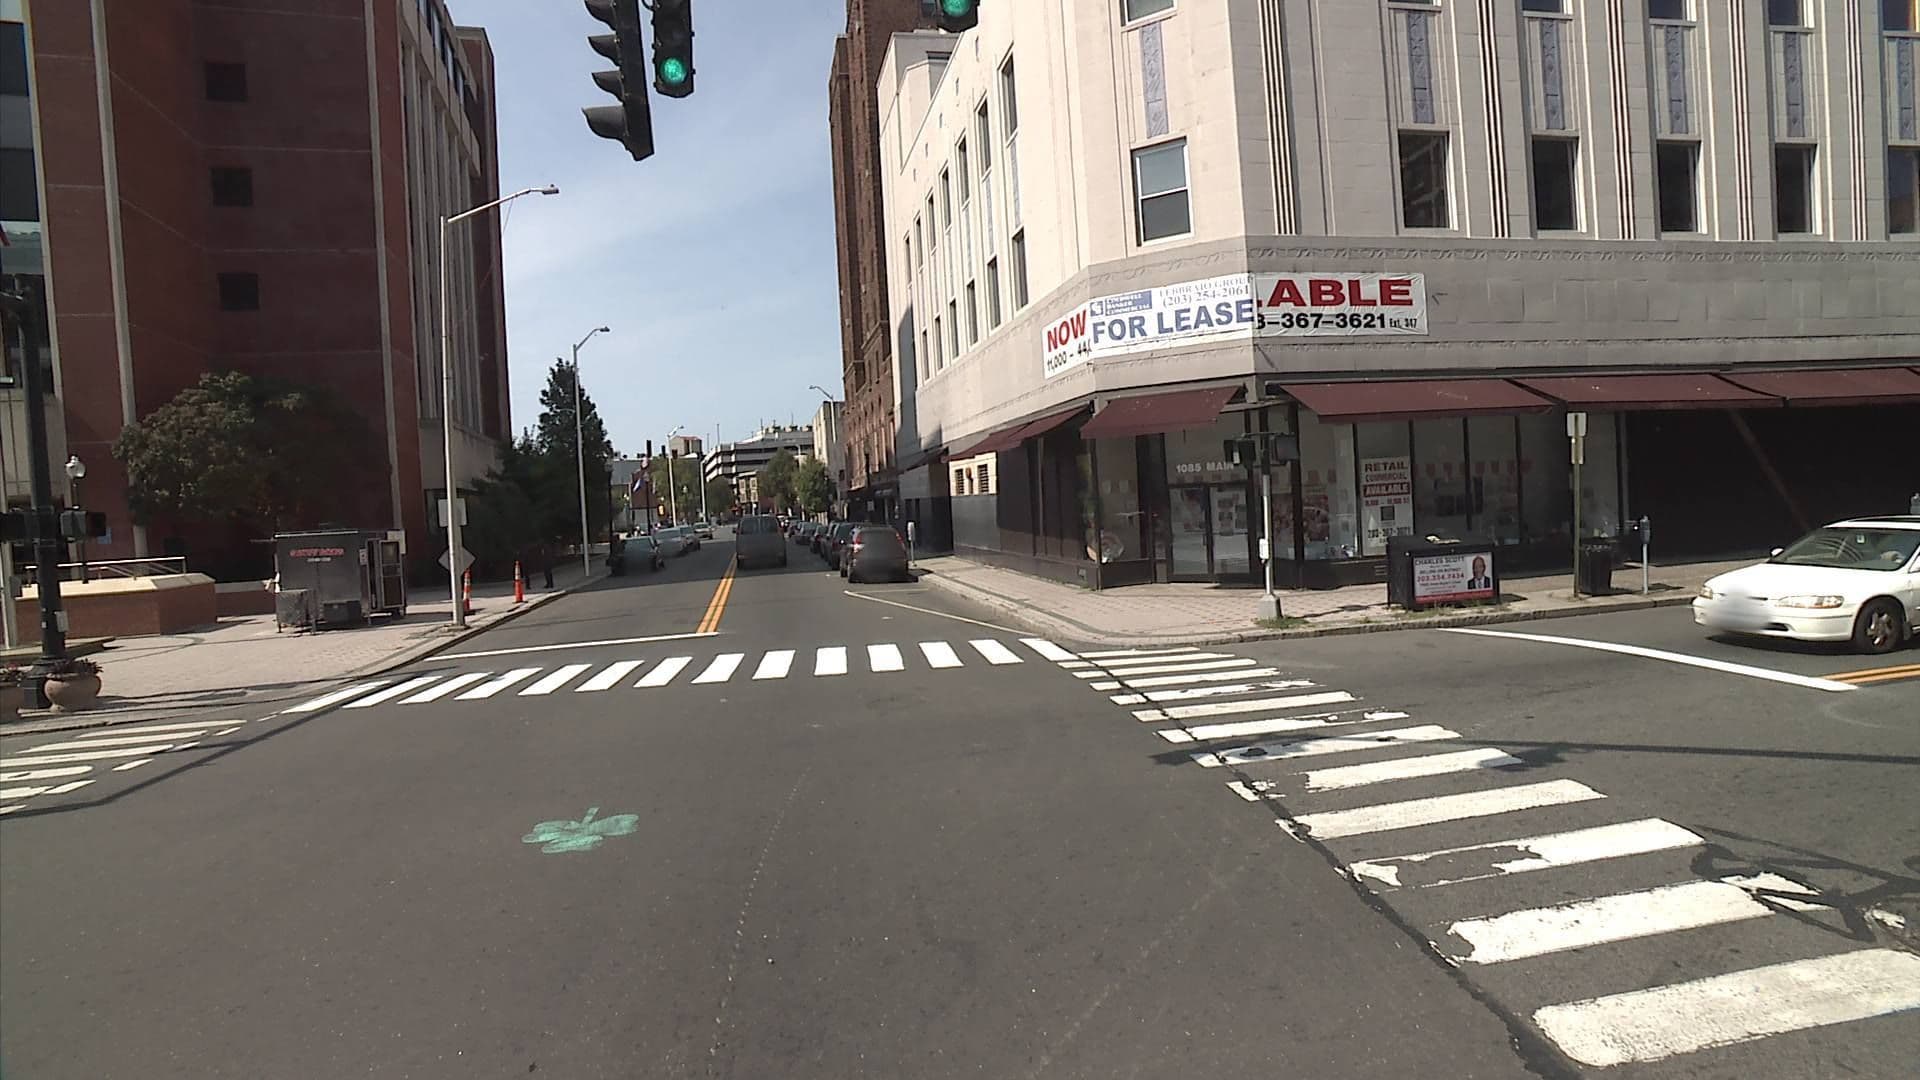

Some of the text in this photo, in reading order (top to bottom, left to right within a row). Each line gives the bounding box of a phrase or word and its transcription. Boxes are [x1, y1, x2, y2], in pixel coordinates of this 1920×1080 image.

[1163, 285, 1249, 308] (203) 254-2061
[1257, 279, 1413, 307] ABLE
[1047, 309, 1087, 352] NOW
[1092, 298, 1255, 344] FOR LEASE
[1176, 463, 1202, 473] 1085
[1364, 461, 1408, 472] RETAIL
[1365, 484, 1408, 495] AVAILABLE
